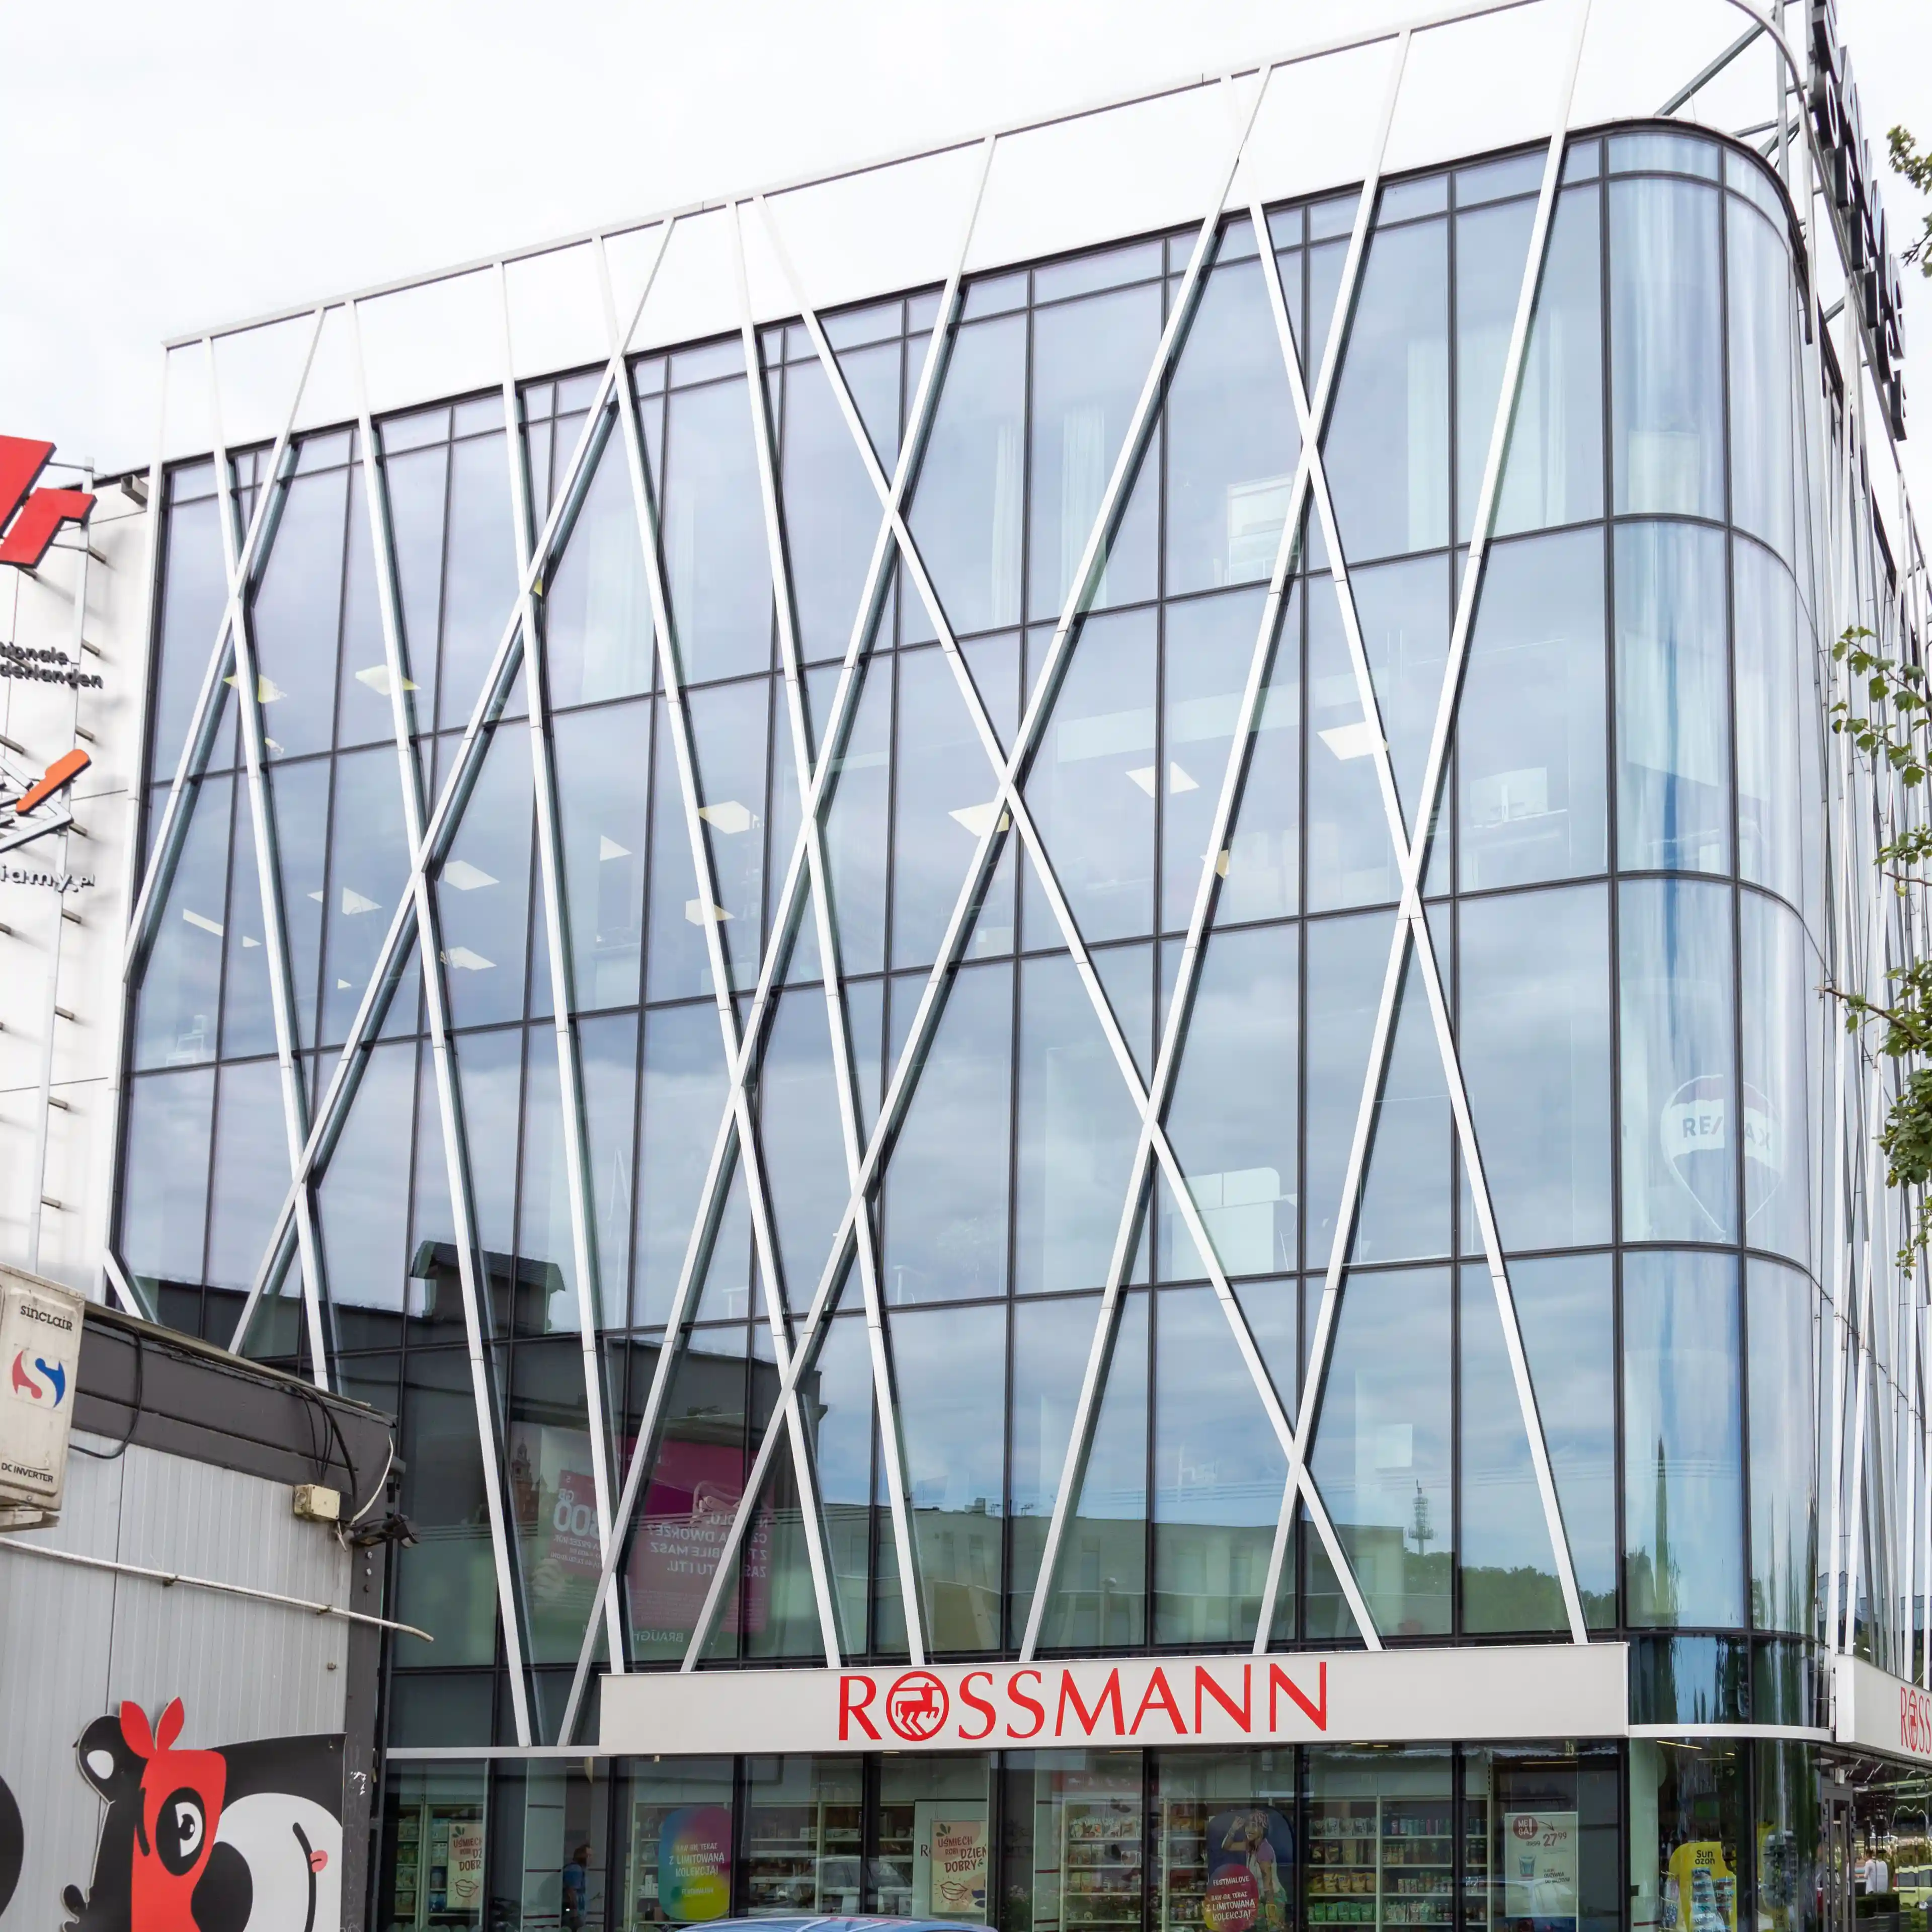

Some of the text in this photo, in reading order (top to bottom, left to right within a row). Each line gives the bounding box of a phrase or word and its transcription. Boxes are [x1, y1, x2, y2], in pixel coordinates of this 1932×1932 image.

[2, 1462, 53, 1483] DC INVERTER
[839, 1661, 1327, 1741] ROSSMANN
[938, 1835, 972, 1848] UŚMIECH
[945, 1847, 958, 1856] ROBI
[1696, 1850, 1713, 1858] Sun
[677, 1852, 725, 1865] LIMITOWANĄ
[944, 1859, 977, 1873] DOBRY
[1213, 1876, 1250, 1886] FESTIWALOVE
[1213, 1899, 1256, 1911] LIMITOWANĄ
[1213, 1910, 1251, 1922] KOLEKCJĄ!
